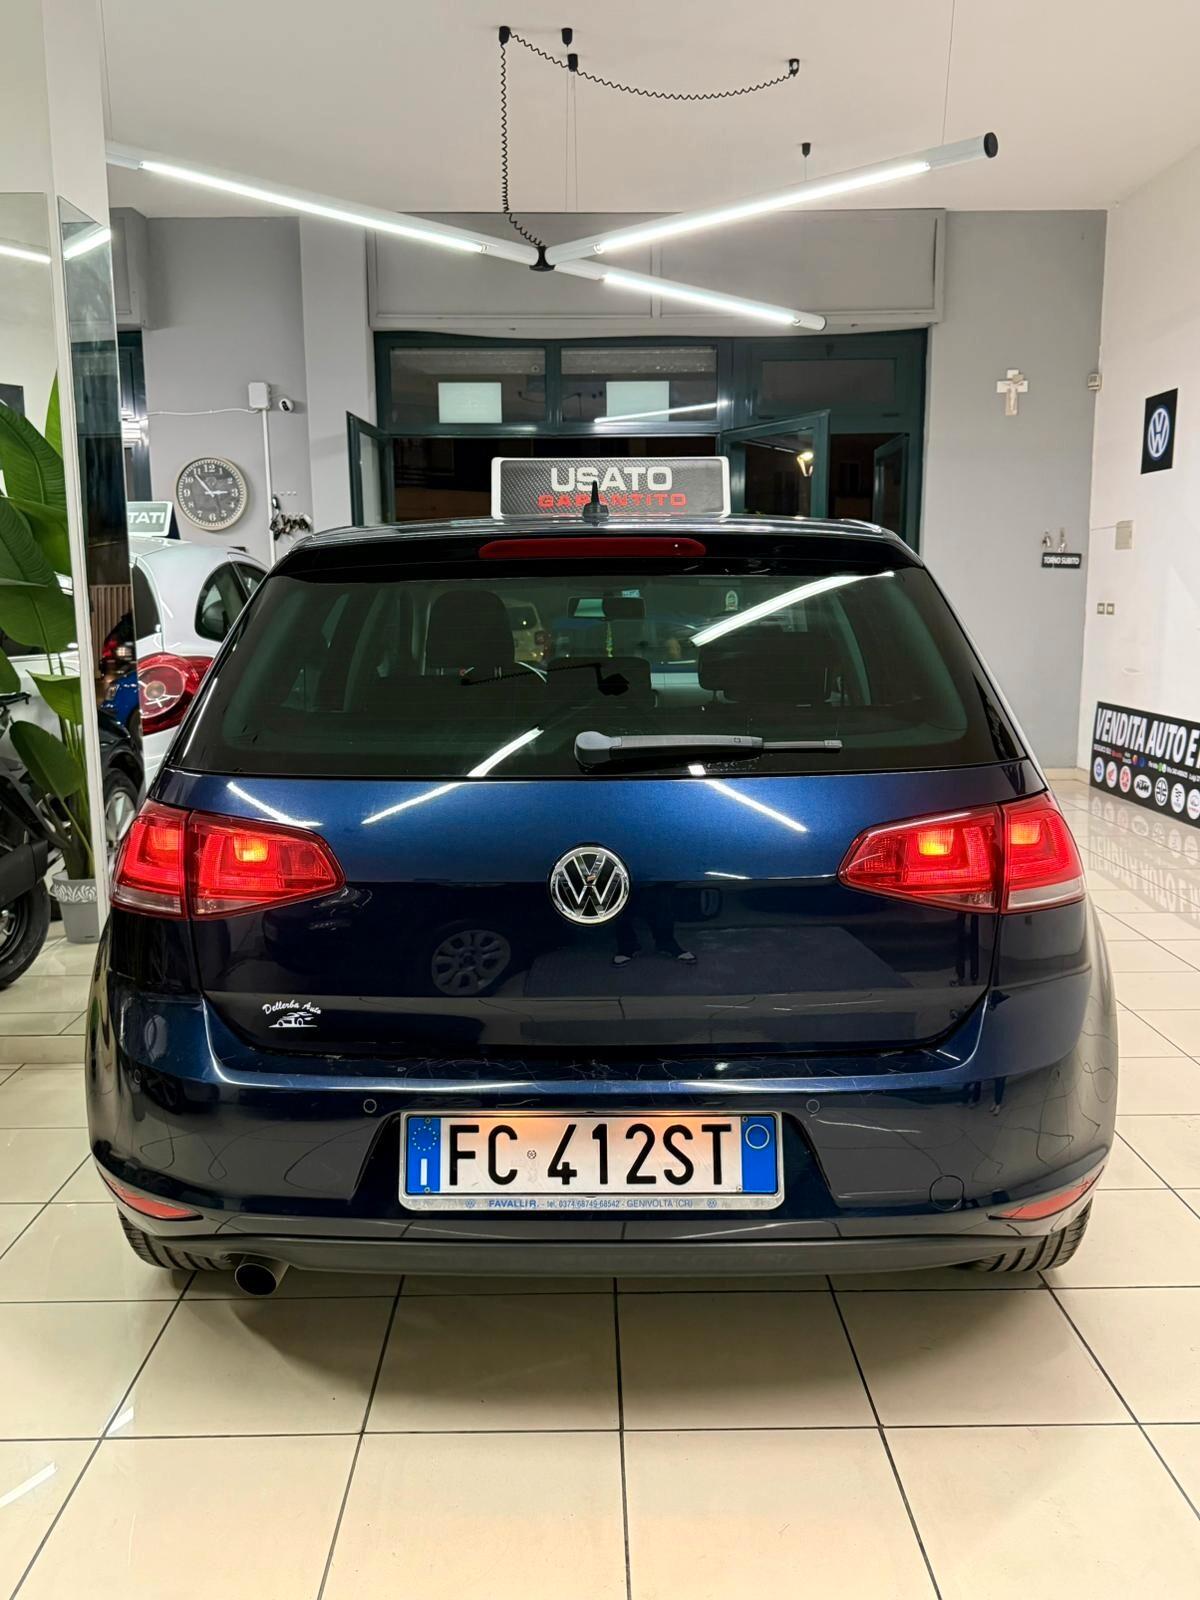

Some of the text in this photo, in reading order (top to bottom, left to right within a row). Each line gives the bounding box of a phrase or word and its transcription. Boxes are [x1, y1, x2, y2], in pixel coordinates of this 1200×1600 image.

[204, 464, 216, 473] 12
[551, 466, 673, 492] USATO
[183, 488, 191, 498] 9
[231, 488, 239, 498] 3
[208, 513, 216, 522] 6
[1095, 707, 1200, 767] VENDITA AUTO E
[302, 1002, 321, 1014] Auto
[449, 1123, 732, 1186] FC 412ST
[626, 1199, 673, 1208] GENIVOLTA
[675, 1199, 694, 1208] (CR)
